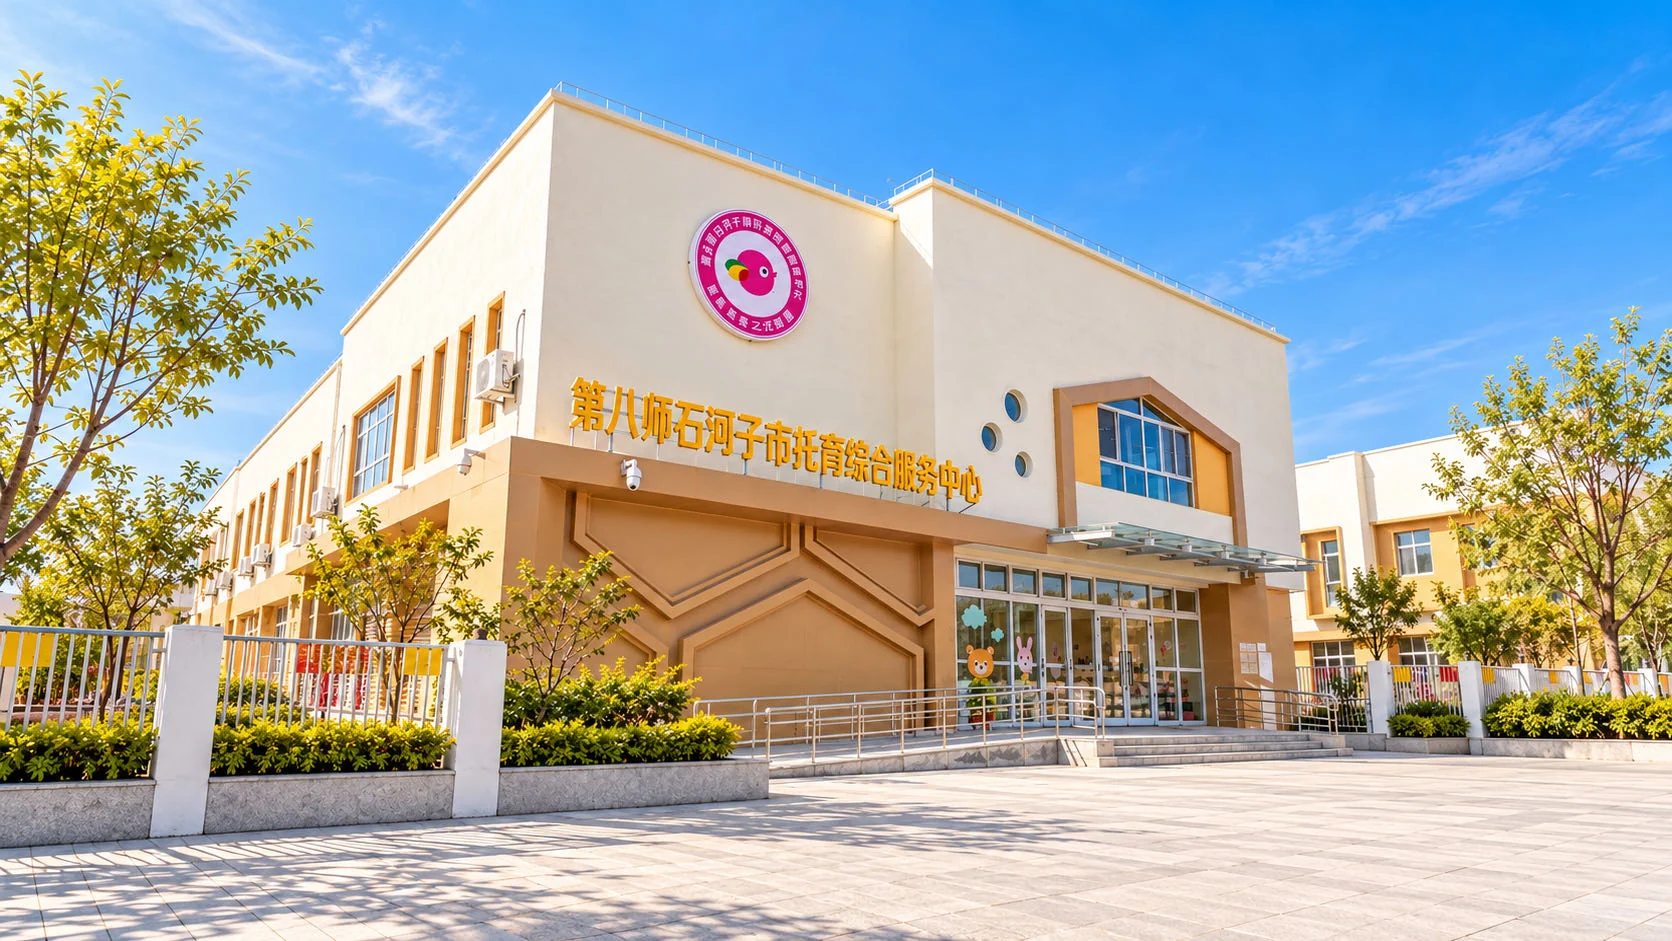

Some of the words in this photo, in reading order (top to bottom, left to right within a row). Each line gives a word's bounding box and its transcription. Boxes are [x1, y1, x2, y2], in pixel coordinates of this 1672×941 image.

[569, 376, 982, 504] 第八师石河子市托育综合服务中心
